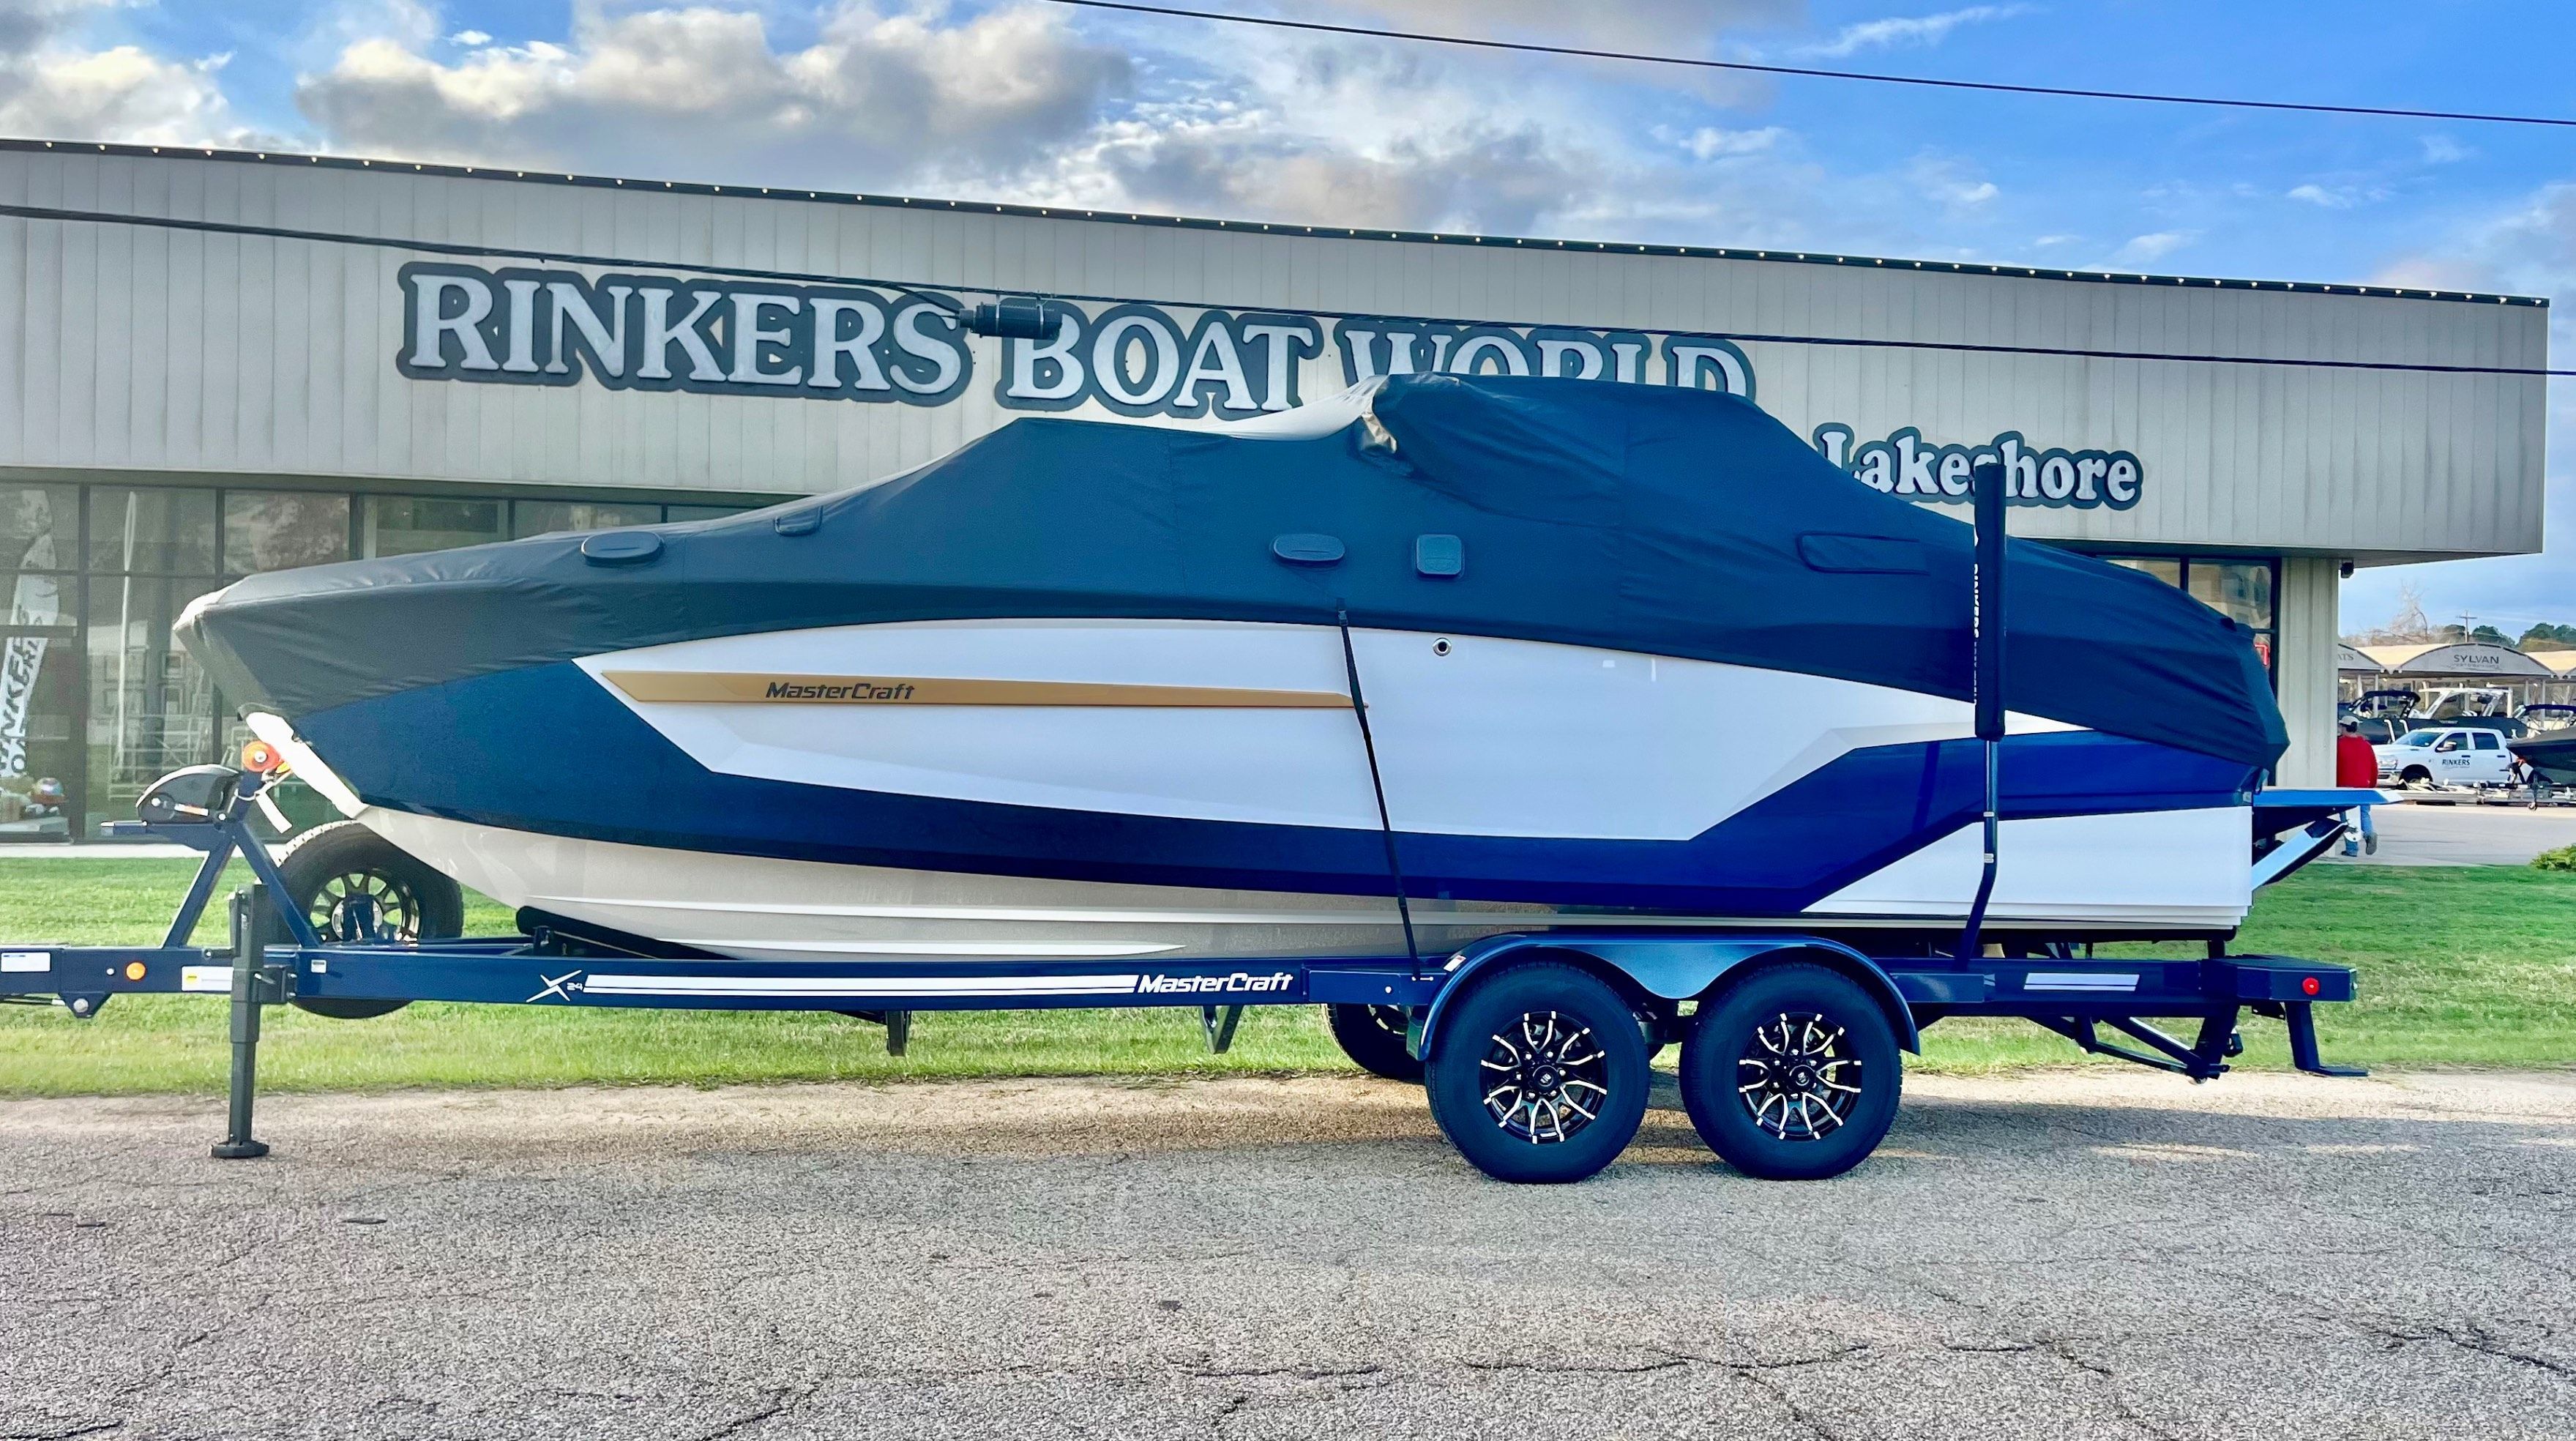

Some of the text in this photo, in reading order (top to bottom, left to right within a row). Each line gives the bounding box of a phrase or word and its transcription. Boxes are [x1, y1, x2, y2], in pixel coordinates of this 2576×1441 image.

[408, 273, 961, 395] RINKERS
[1007, 312, 1314, 411] BOAT
[2454, 654, 2499, 663] SYLVAN
[766, 682, 915, 699] MasterCraft
[1137, 972, 1293, 993] MasterCraft
